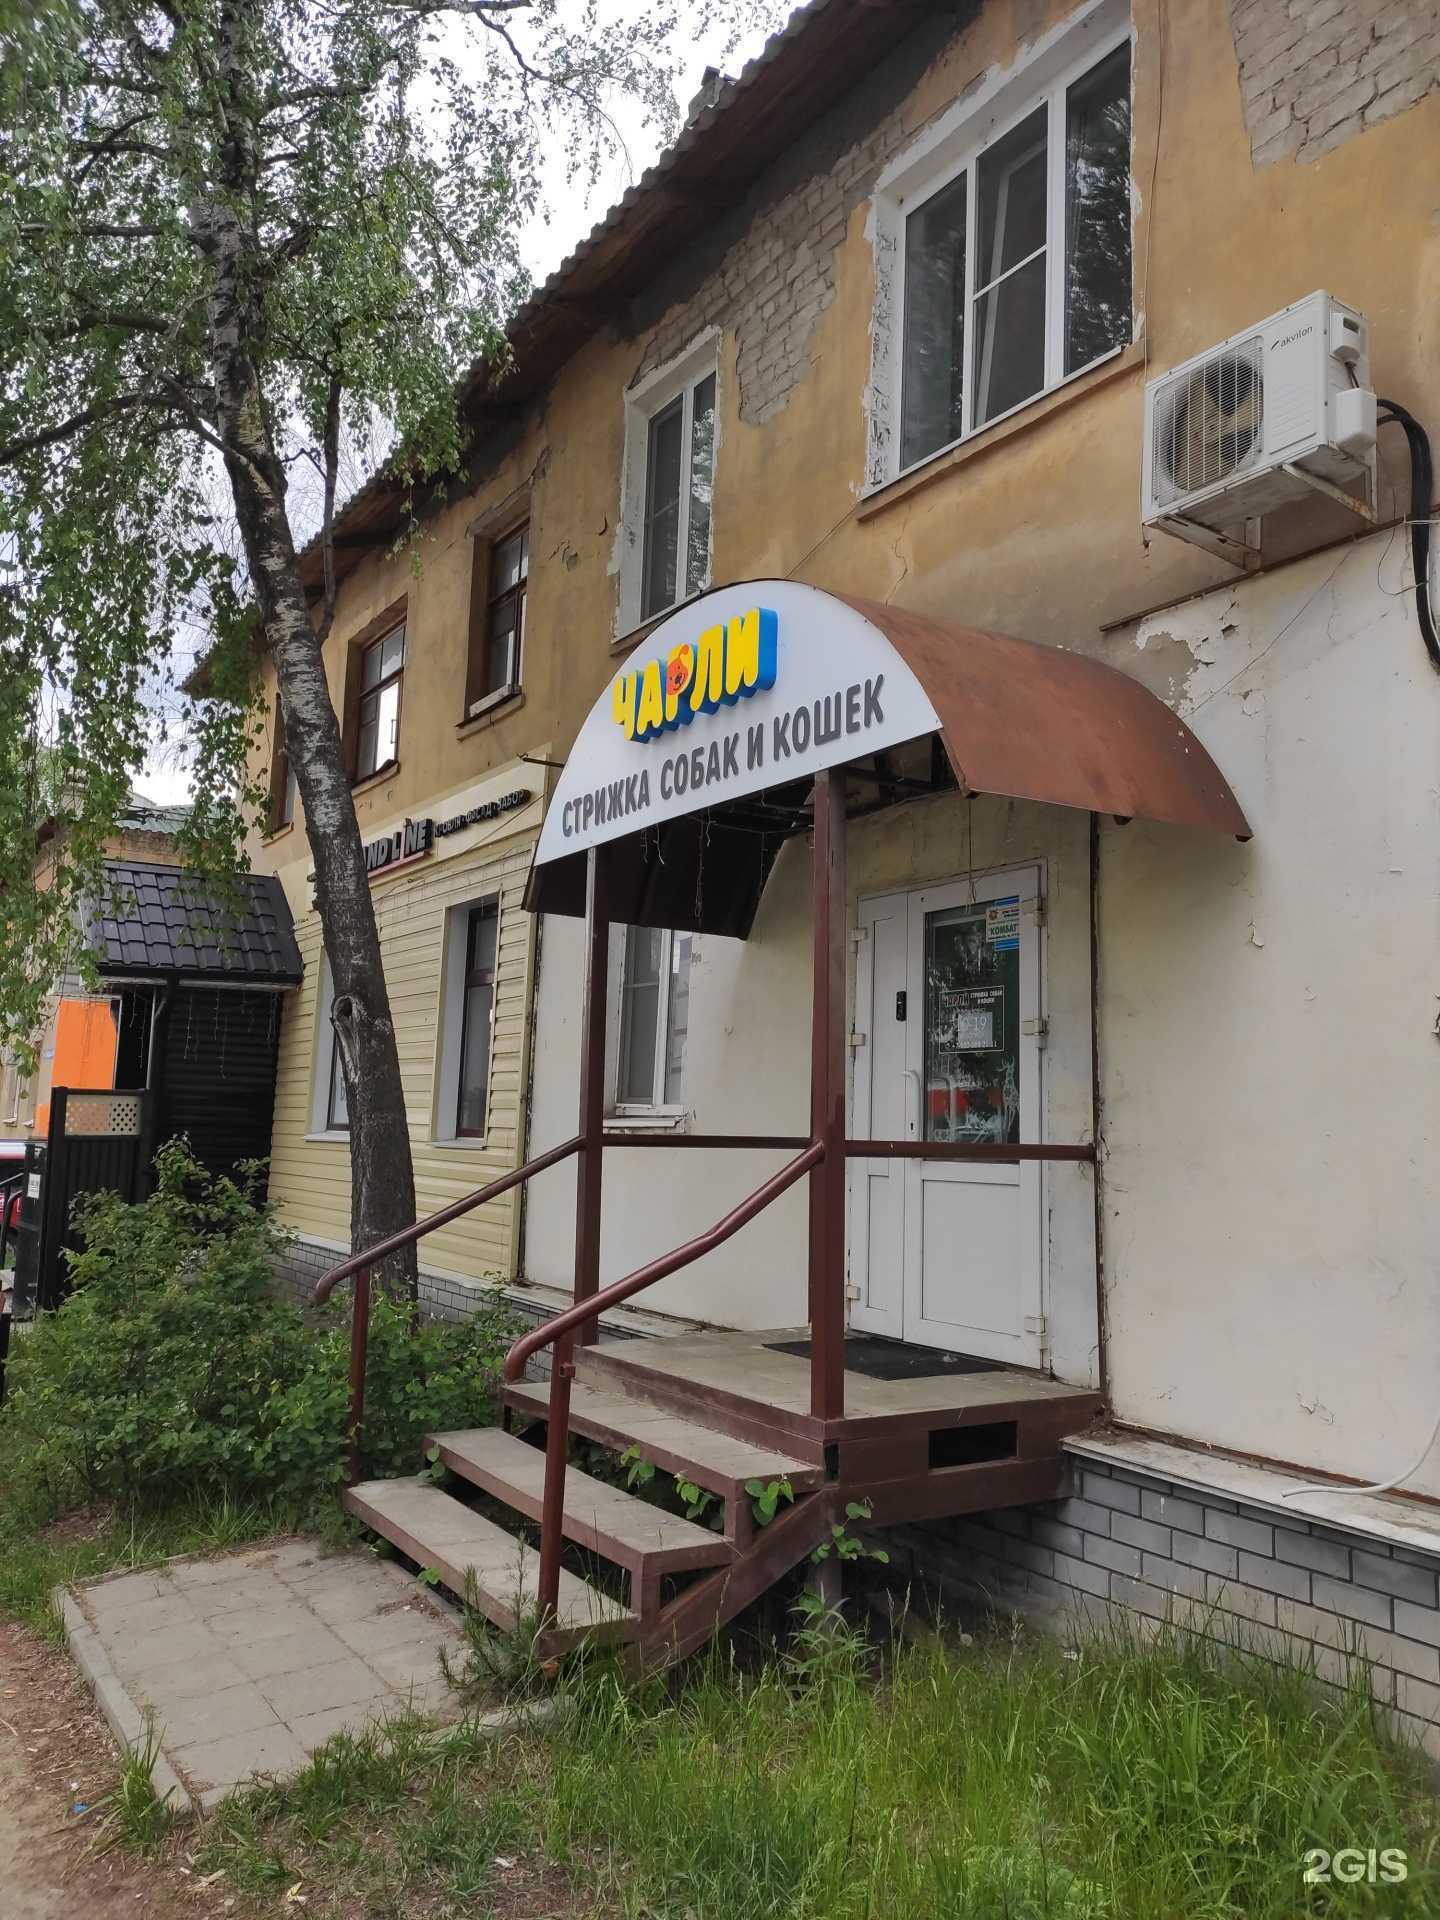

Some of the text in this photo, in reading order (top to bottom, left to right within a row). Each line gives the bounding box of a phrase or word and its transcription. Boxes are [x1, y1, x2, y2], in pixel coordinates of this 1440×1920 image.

[612, 606, 777, 743] ЧАРЛИ
[562, 674, 885, 837] СТРИЖКА СОБАК И КОШЕК
[990, 923, 1017, 936] КОМБАТ
